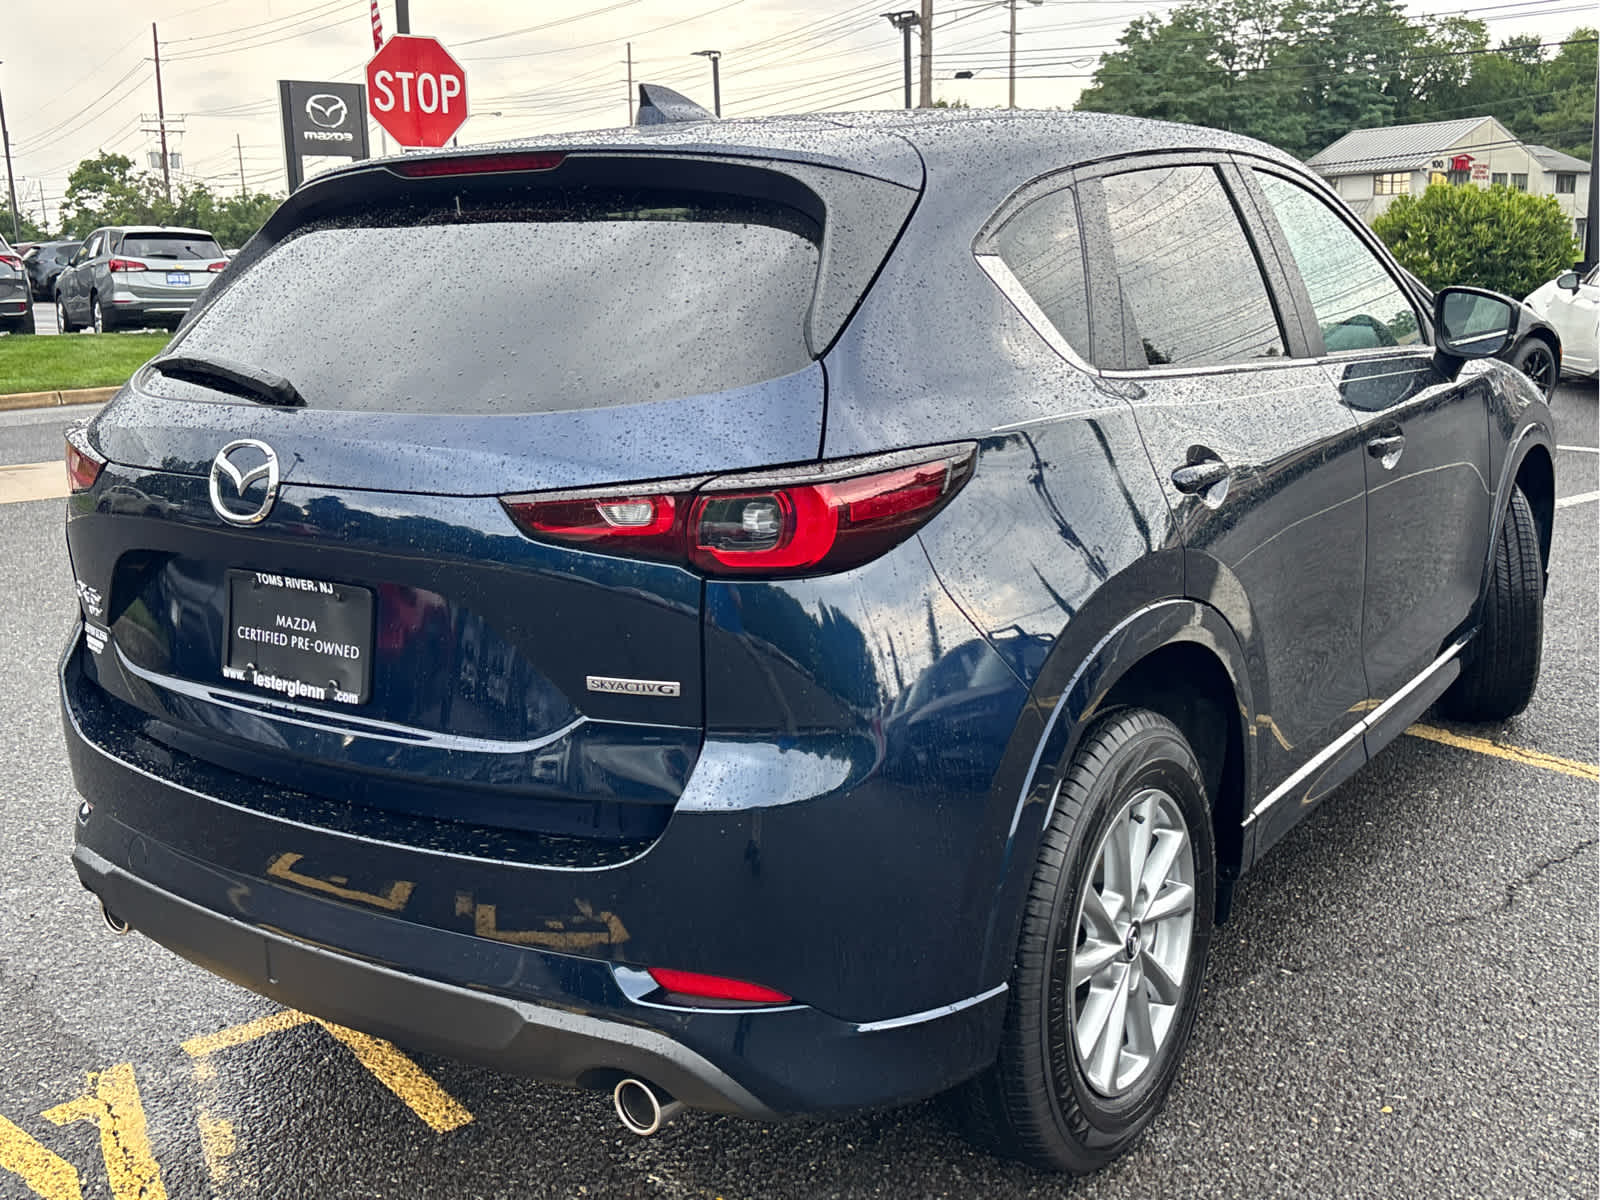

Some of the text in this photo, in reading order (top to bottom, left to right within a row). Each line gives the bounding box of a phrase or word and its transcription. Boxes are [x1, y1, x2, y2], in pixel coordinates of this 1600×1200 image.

[374, 70, 461, 114] STOP
[1432, 159, 1444, 169] 100
[256, 572, 334, 594] TOMS RIVER, NJ
[275, 614, 317, 633] MAZDA
[237, 626, 360, 659] CERTIFIED PRE-OWNED
[252, 670, 325, 700] lesterglenn
